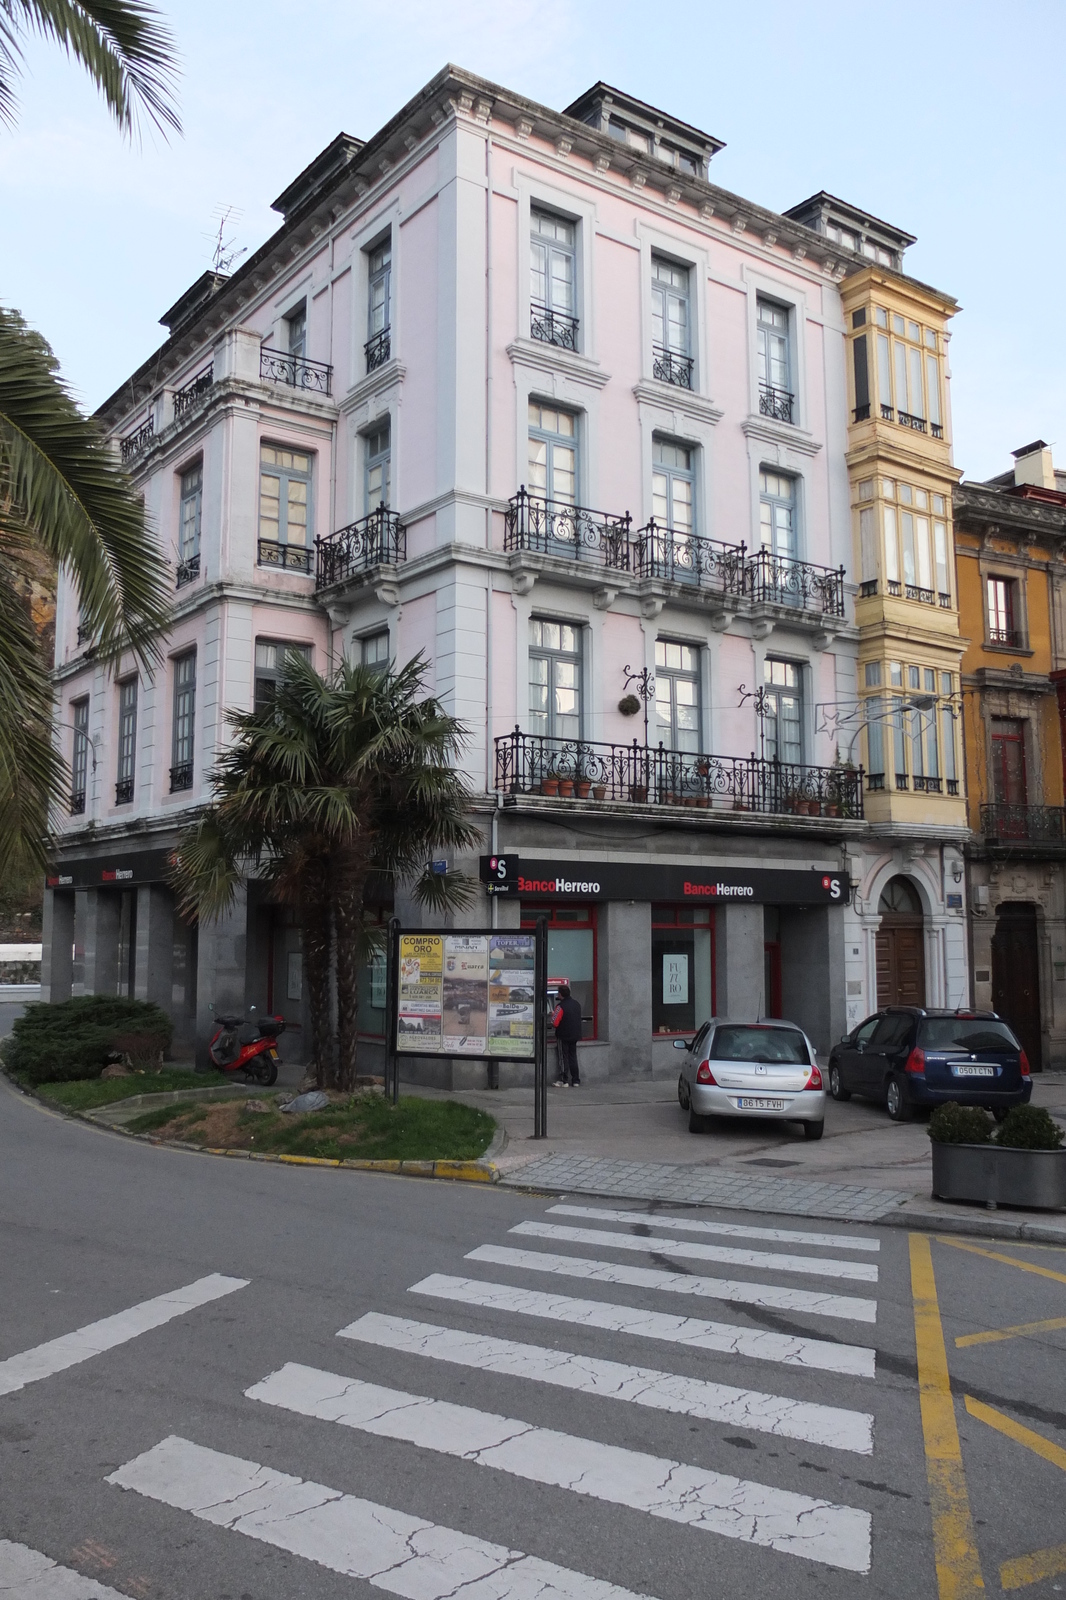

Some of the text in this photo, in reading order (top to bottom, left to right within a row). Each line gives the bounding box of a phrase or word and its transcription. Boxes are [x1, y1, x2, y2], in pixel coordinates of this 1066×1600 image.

[497, 859, 507, 879] S
[517, 876, 601, 893] BancoHerrero
[683, 881, 754, 896] BancoHerrero
[829, 879, 841, 899] S
[403, 937, 440, 945] COMPRO
[413, 945, 432, 953] ORO
[669, 983, 682, 993] RO
[958, 1067, 993, 1075] 0501 CTN
[743, 1098, 782, 1109] 8615 FVH
